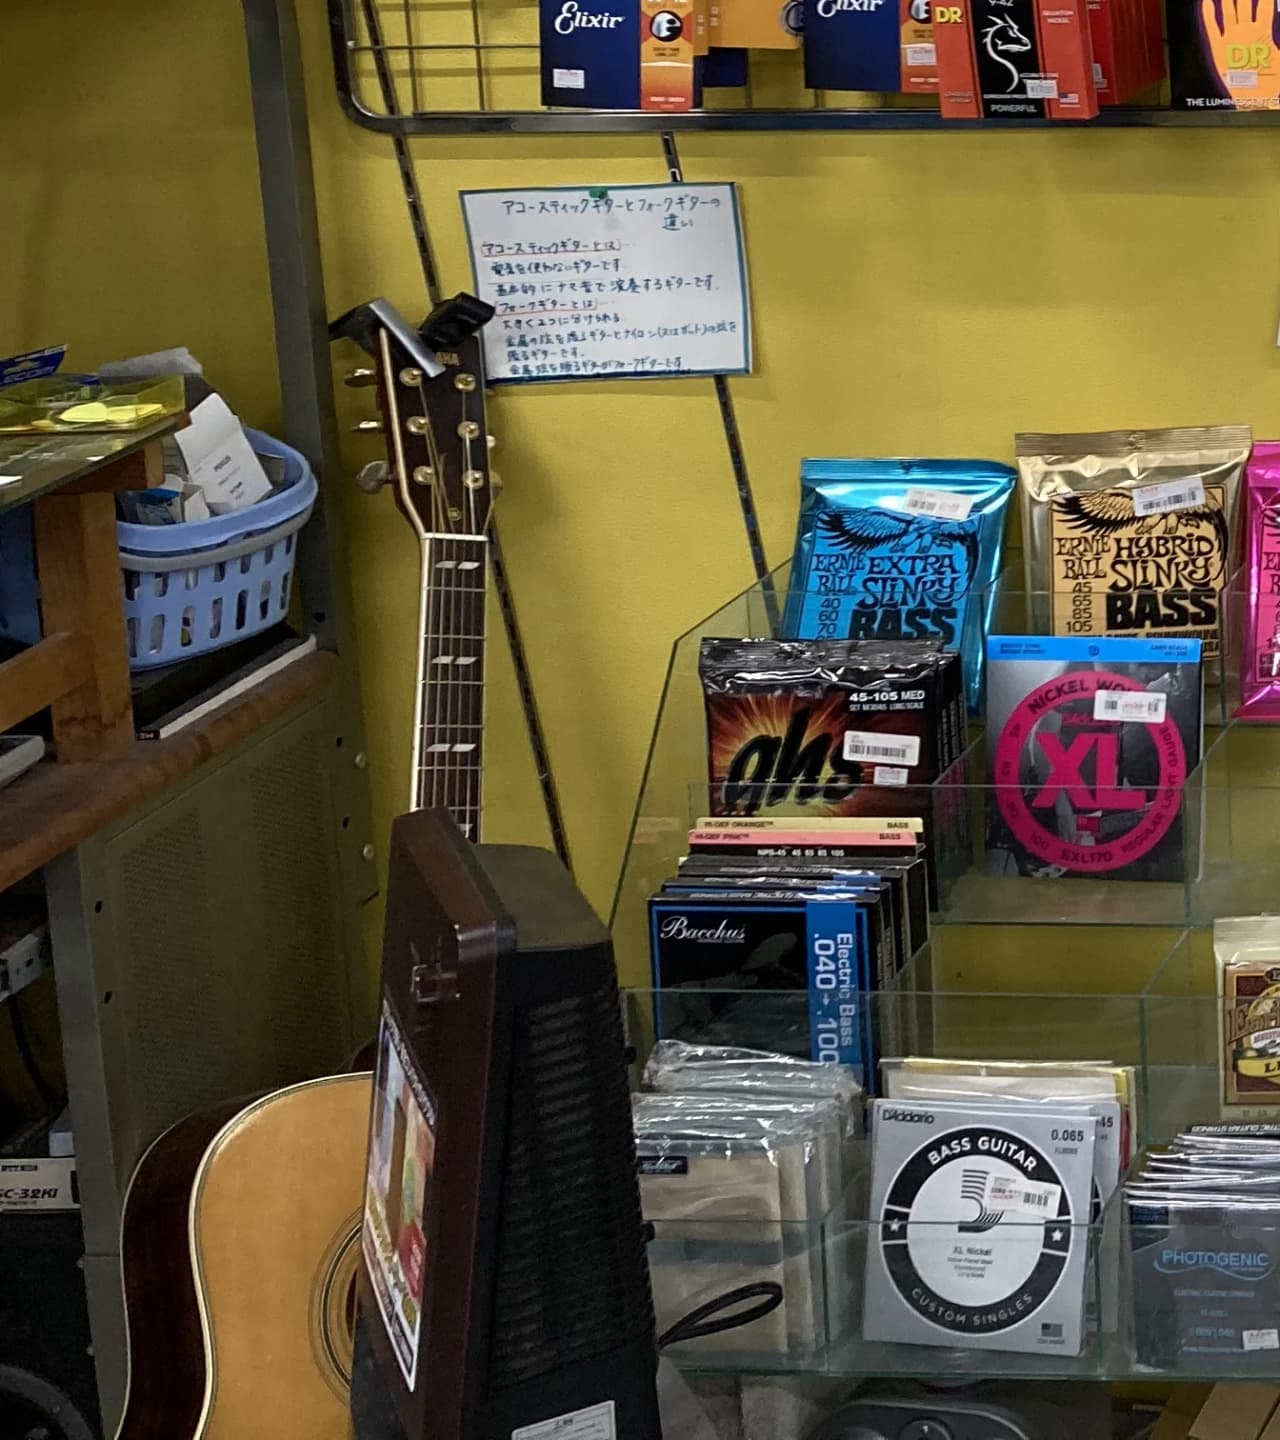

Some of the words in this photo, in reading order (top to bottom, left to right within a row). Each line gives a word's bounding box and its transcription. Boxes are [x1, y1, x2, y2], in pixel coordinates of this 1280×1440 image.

[555, 1, 623, 34] Elixir
[936, 6, 962, 24] DR
[1115, 534, 1213, 558] HYBRID
[867, 554, 956, 575] EXTRA
[1110, 559, 1213, 592] SLINKY
[1107, 589, 1217, 630] BASS
[849, 691, 898, 702] 45-105
[901, 691, 925, 701] MED
[1032, 732, 1147, 810] XL
[660, 915, 746, 941] Bacchus
[1051, 1129, 1084, 1143] 0.065
[927, 1134, 972, 1166] BASS
[976, 1134, 1038, 1173] GUITAR
